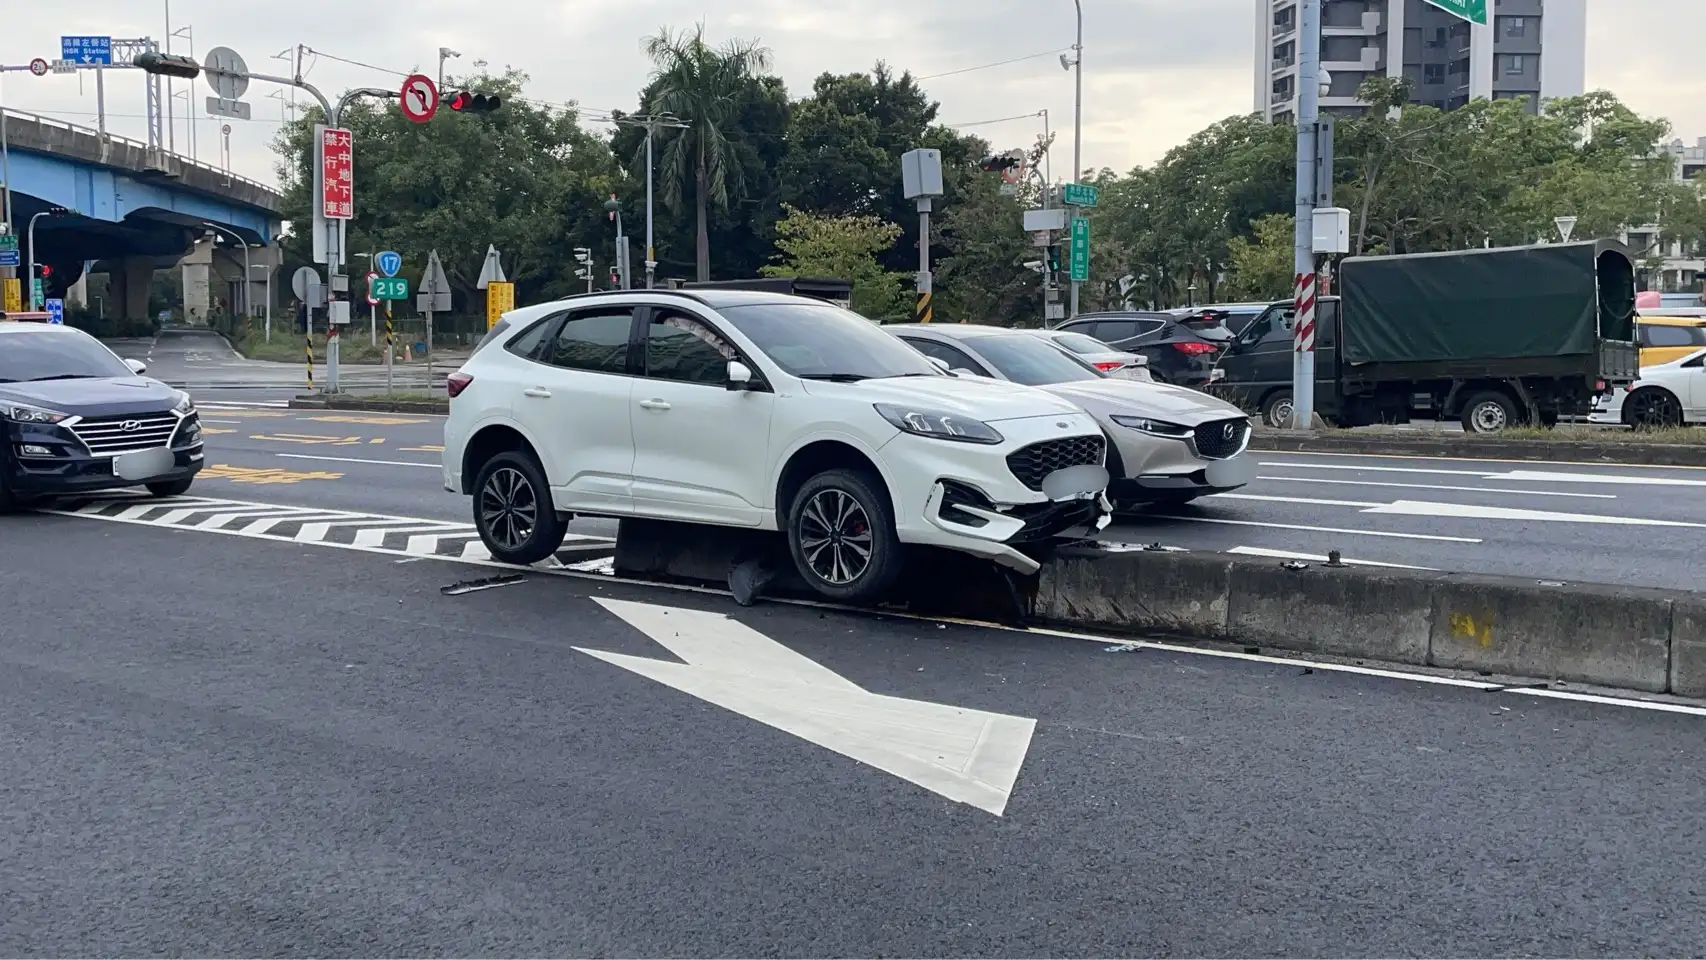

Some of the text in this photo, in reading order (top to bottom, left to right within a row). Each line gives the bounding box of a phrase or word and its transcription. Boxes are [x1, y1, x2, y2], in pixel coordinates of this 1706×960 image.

[325, 132, 338, 214] 禁行汽車
[338, 133, 350, 215] 大中地下道
[384, 256, 398, 270] 17
[376, 282, 406, 295] 219
